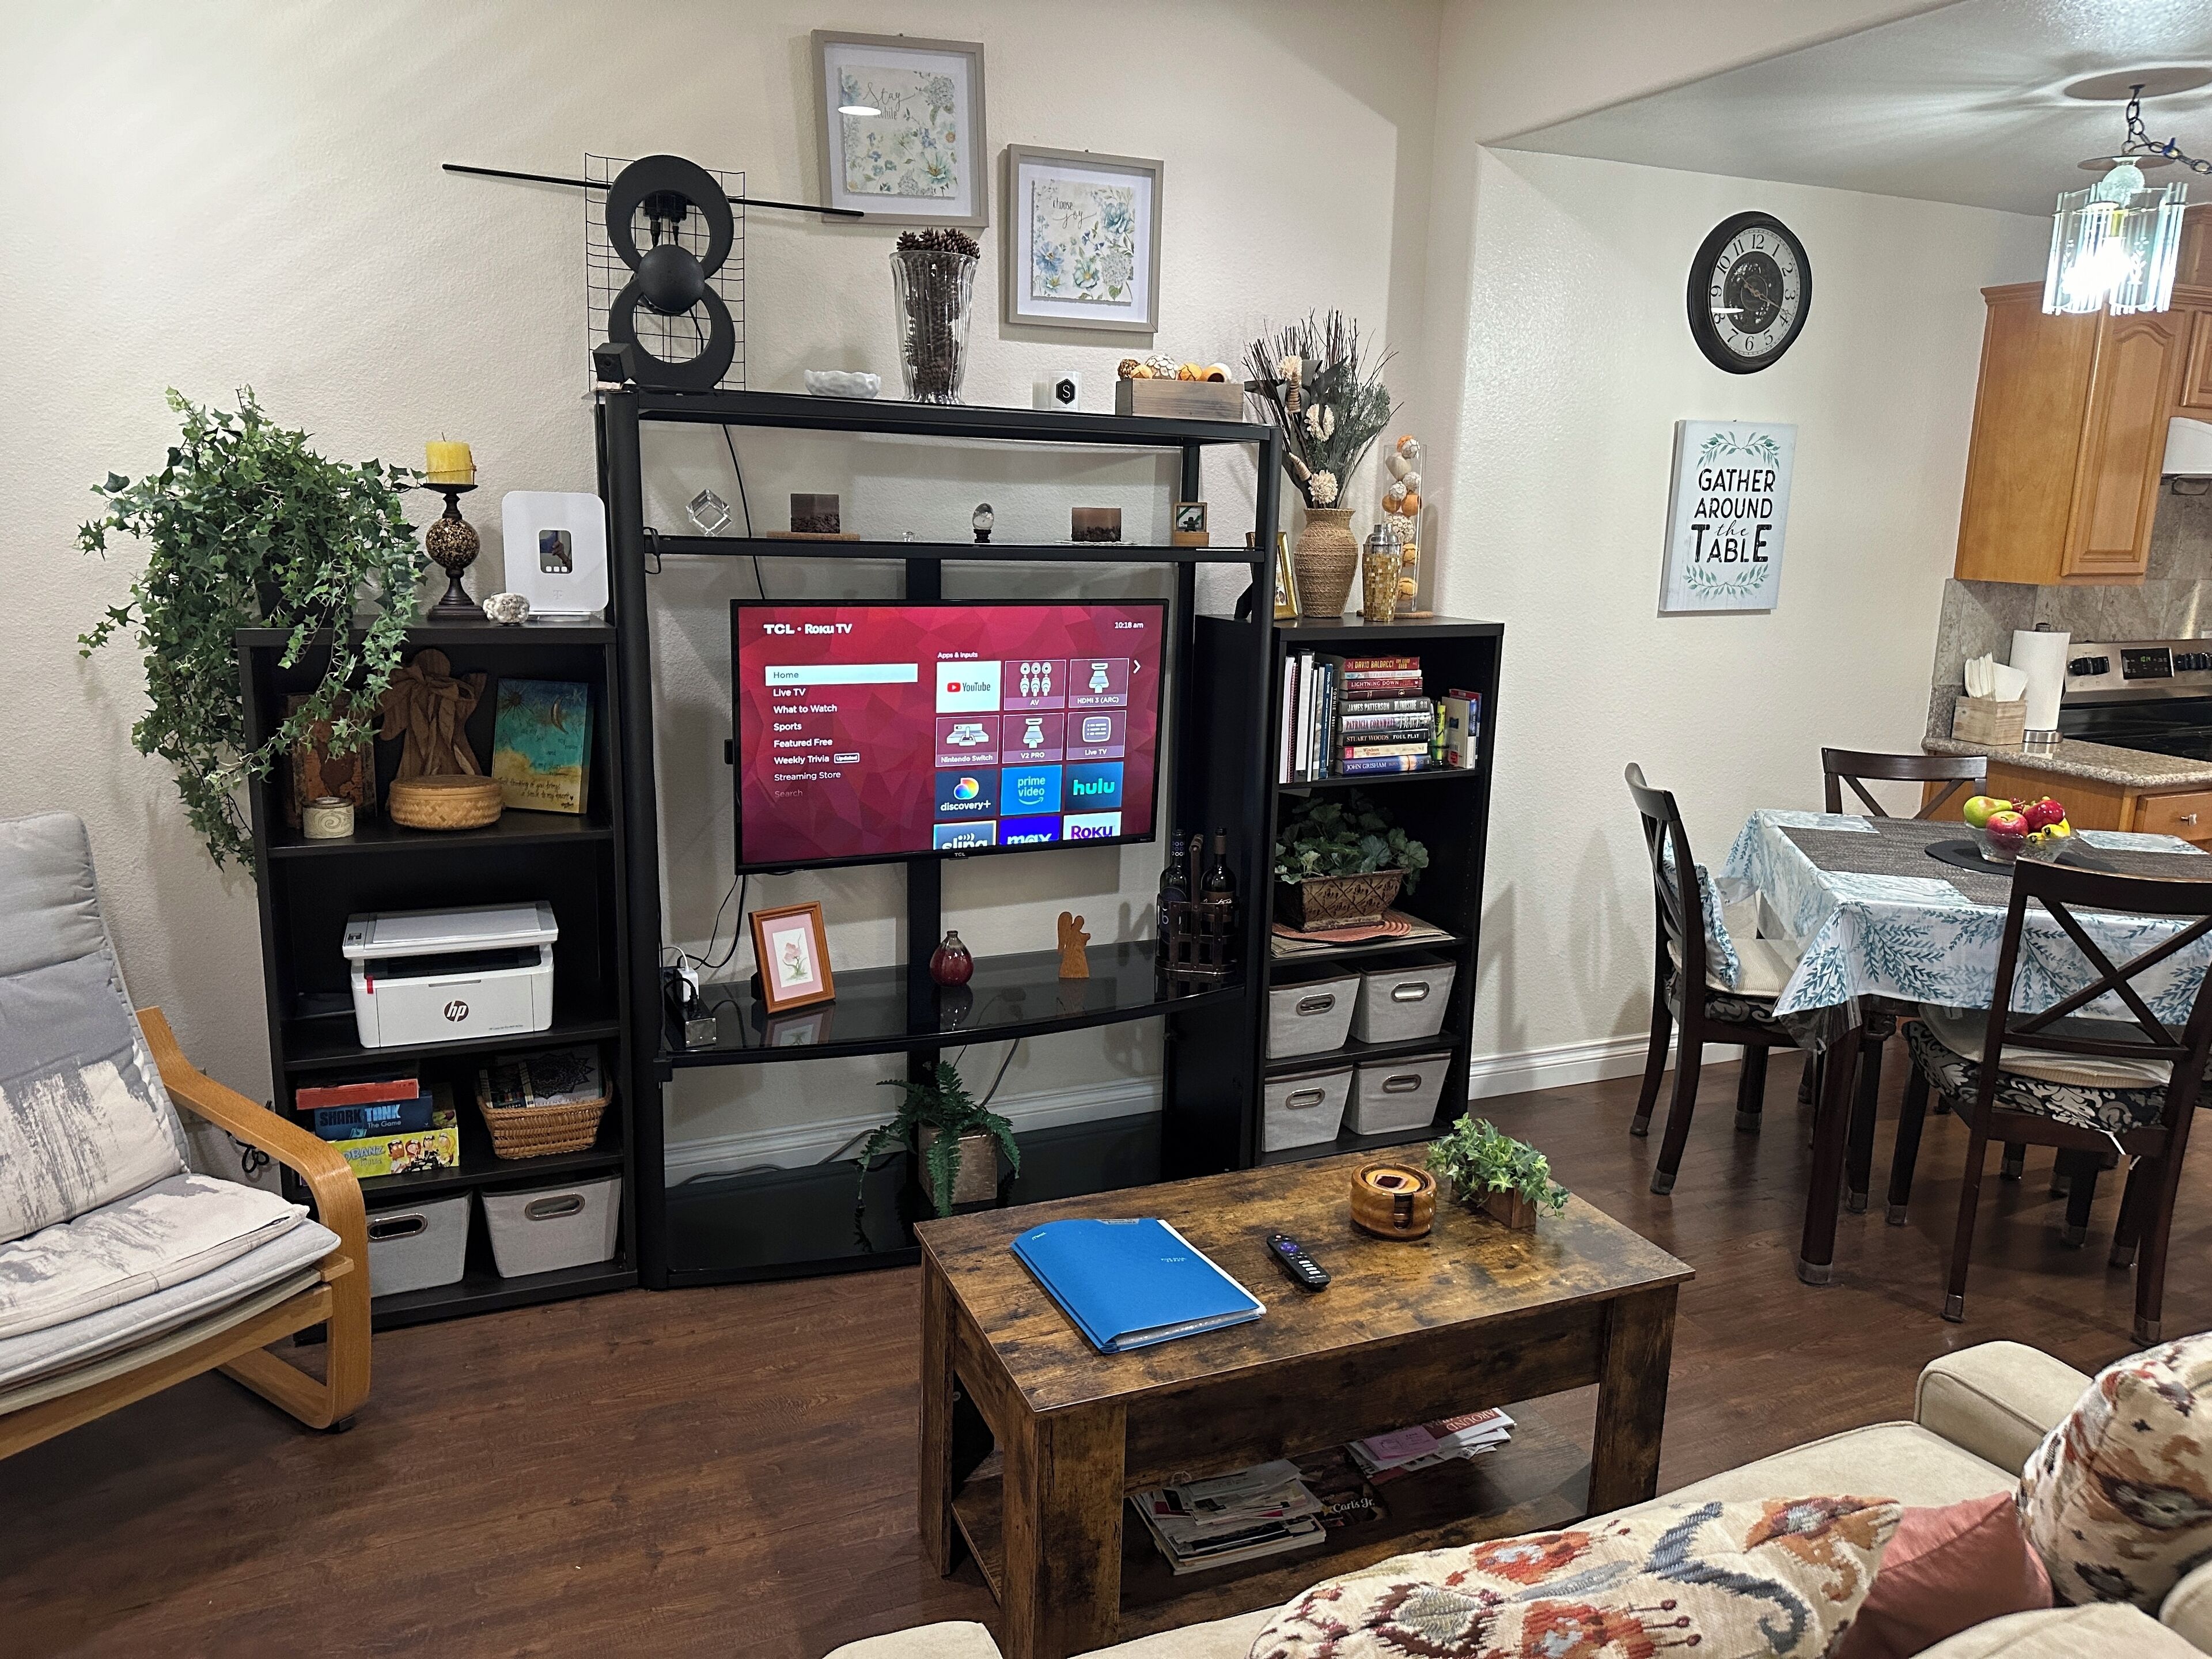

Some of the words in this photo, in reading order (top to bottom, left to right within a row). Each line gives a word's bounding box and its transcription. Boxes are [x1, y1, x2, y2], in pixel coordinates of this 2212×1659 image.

[863, 82, 915, 112] Stay
[1053, 197, 1073, 210] choose
[1053, 211, 1097, 229] joy
[1733, 239, 1744, 256] 11
[1751, 234, 1764, 249] 12
[1771, 244, 1781, 257] 1
[1717, 256, 1730, 275] 10
[1781, 263, 1793, 276] 2
[1745, 336, 1754, 351] 6
[1763, 329, 1773, 345] 5
[1062, 385, 1070, 398] S
[1699, 468, 1775, 492] GATHER
[1694, 498, 1772, 518] AROUND
[1714, 520, 1749, 537] the
[1691, 524, 1772, 563] TABLE
[763, 624, 795, 634] TCL
[805, 624, 834, 634] Roku
[836, 623, 853, 634] TV
[773, 688, 791, 696] Live
[793, 688, 806, 696] TV
[962, 682, 991, 692] YouTube
[1100, 696, 1119, 704] (ARC)
[773, 706, 797, 714] What
[810, 704, 838, 713] Watch
[1347, 703, 1363, 712] JAMES
[1364, 702, 1390, 711] PATTERSON
[773, 722, 802, 732] Sports
[1346, 720, 1369, 730] PATRICIA
[774, 739, 812, 748] Featured
[814, 738, 833, 747] Free
[774, 756, 806, 765] Weekly
[807, 755, 830, 764] Trivia
[941, 755, 971, 763] Nintendo
[972, 754, 993, 762] Switch
[774, 772, 817, 782] Streaming
[1017, 776, 1046, 788] prime
[774, 789, 803, 798] Search
[1018, 787, 1045, 797] video
[1073, 778, 1116, 796] hulu
[940, 800, 991, 812] discovery+
[446, 1000, 467, 1022] hp
[320, 1109, 362, 1127] SHARK
[365, 1104, 401, 1122] TANK
[1446, 1410, 1495, 1431] AROUND
[1333, 1499, 1360, 1514] Carl's
[1361, 1498, 1375, 1508] Jr.
